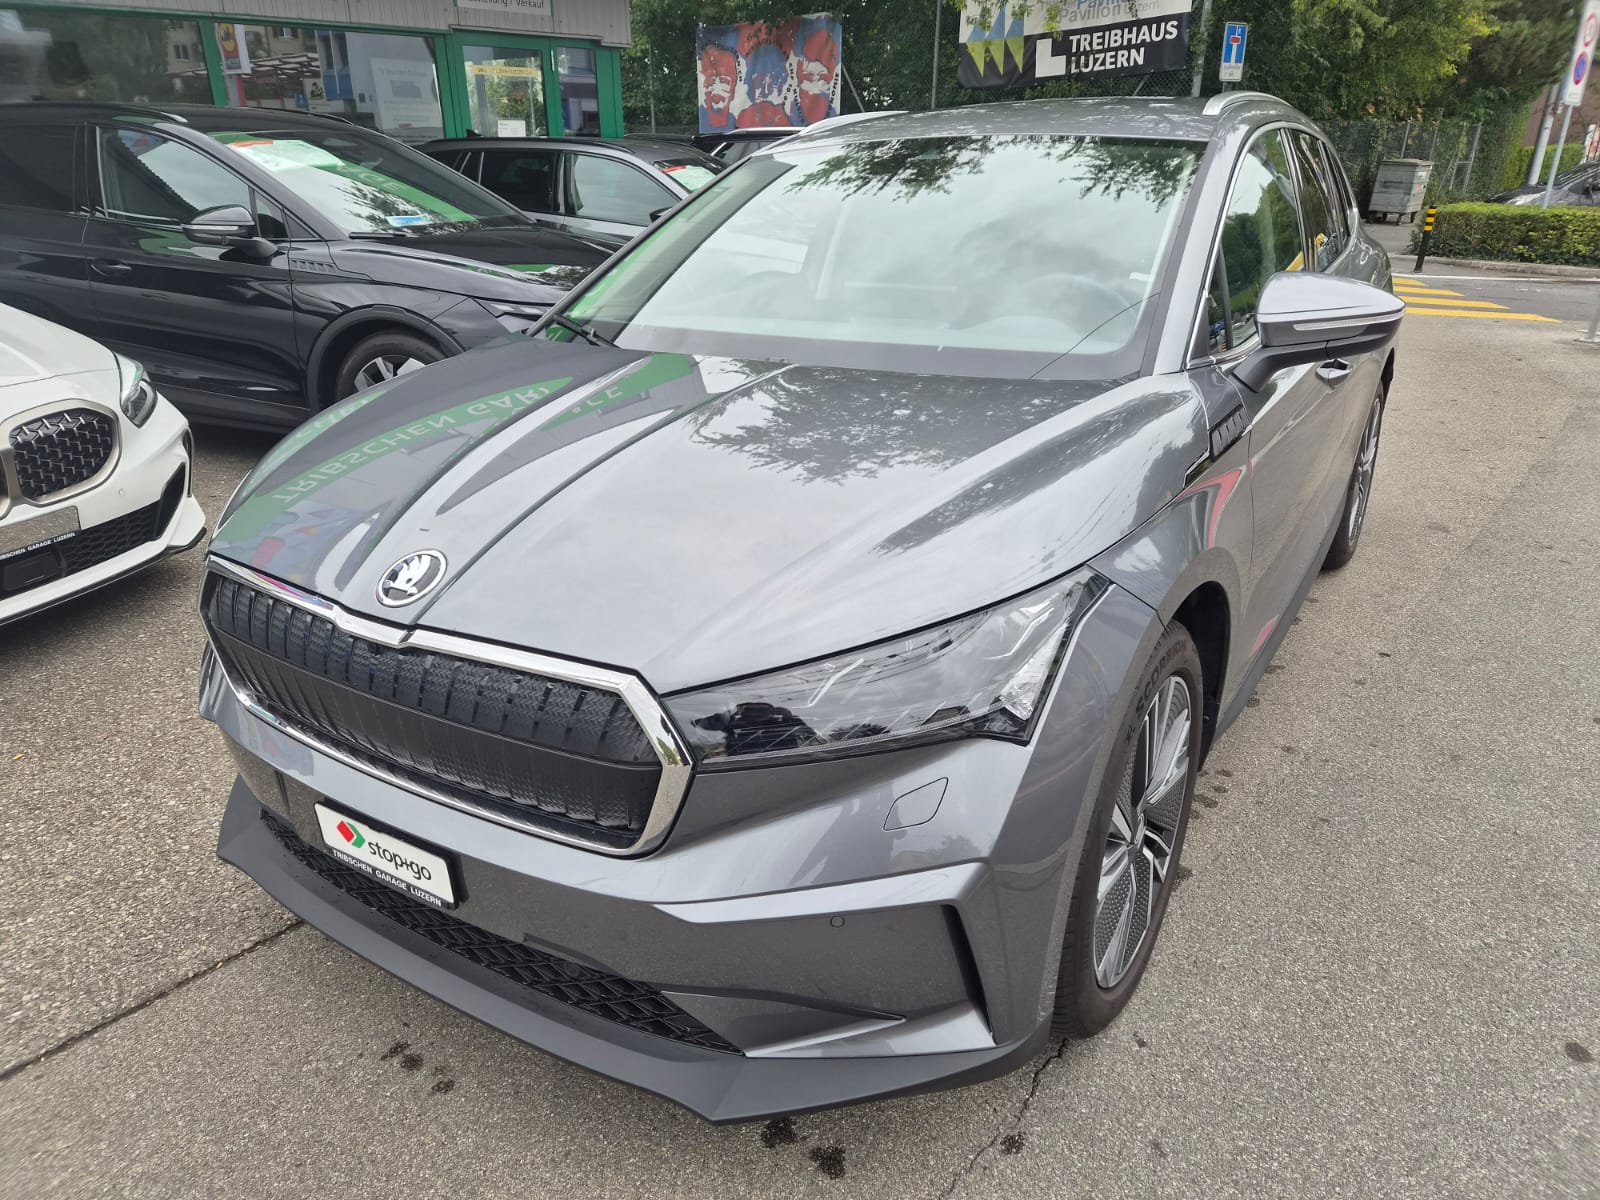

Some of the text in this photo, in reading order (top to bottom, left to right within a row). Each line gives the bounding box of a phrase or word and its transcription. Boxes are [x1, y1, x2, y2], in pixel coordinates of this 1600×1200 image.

[1060, 4, 1121, 23] Pavillon
[1124, 1, 1160, 15] Lzern
[1069, 20, 1179, 53] TREIBHAUS
[1070, 47, 1146, 75] LUZERN
[332, 849, 442, 907] TRIBSCHEN GARAGE LUZERN
